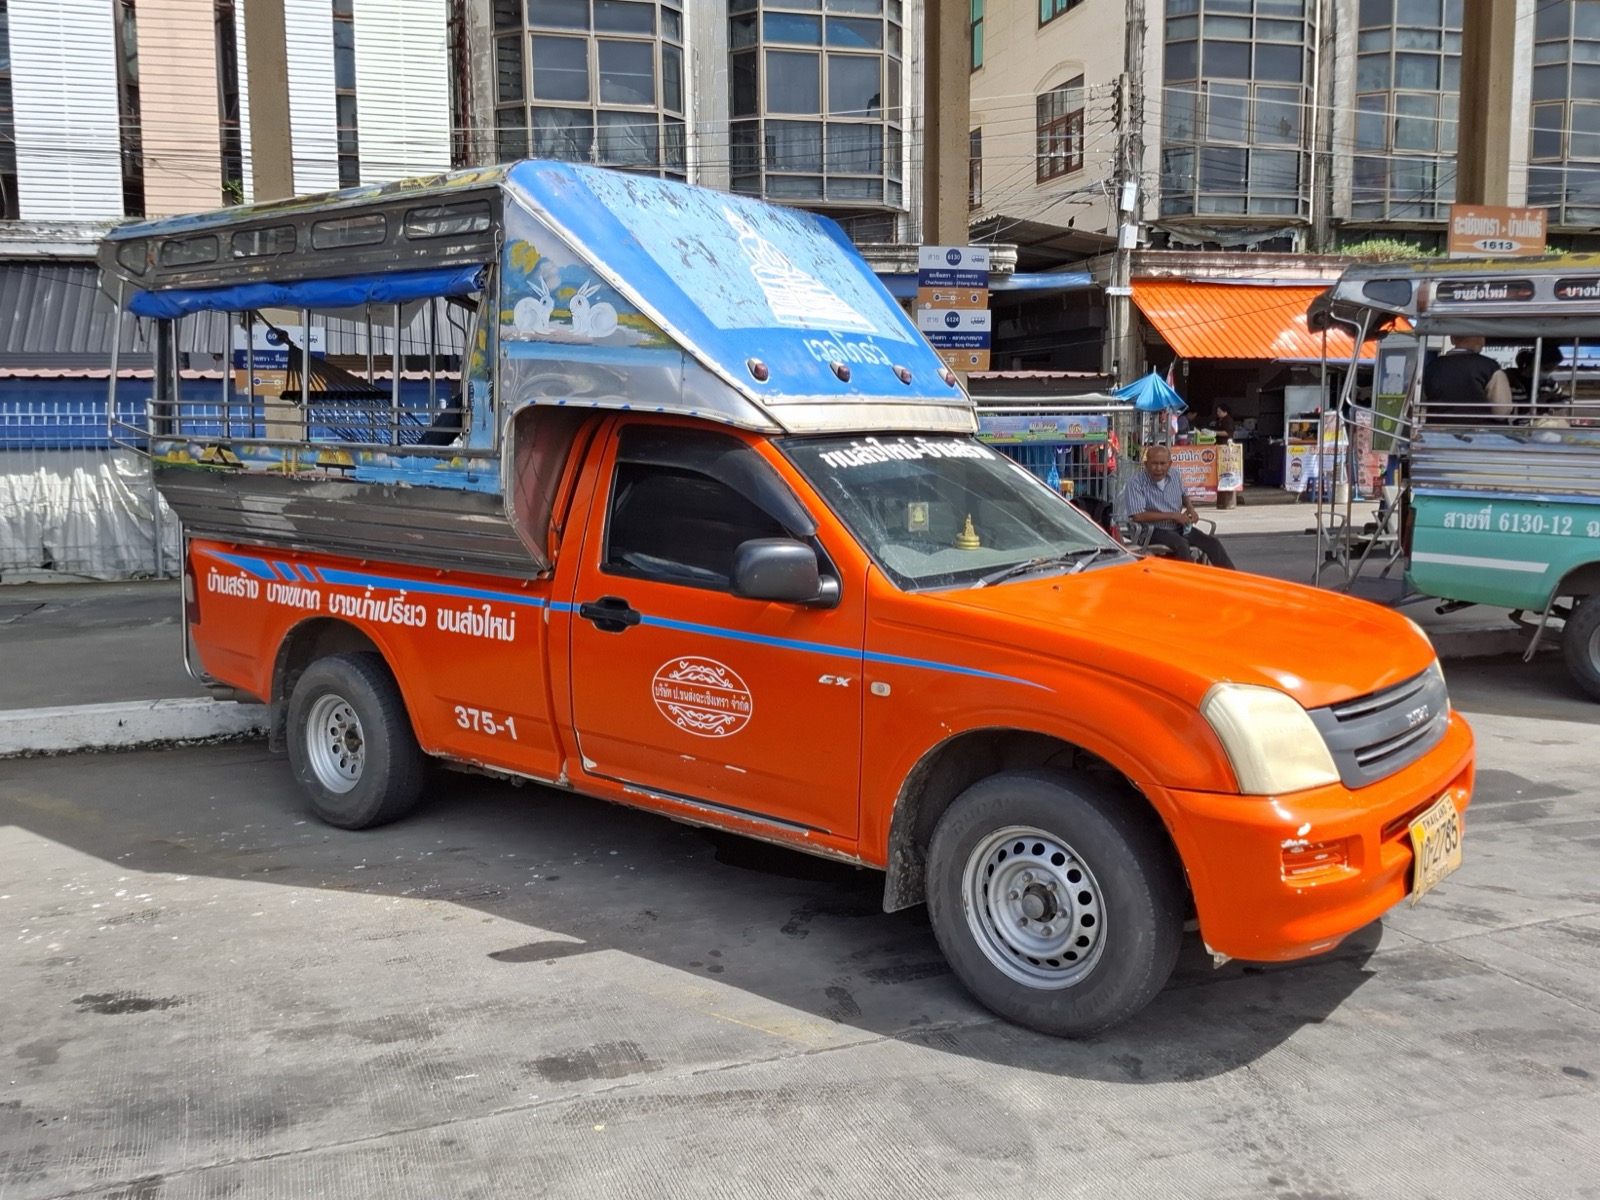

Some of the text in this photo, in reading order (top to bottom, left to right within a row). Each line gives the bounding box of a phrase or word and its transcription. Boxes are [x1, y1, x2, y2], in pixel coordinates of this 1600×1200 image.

[1454, 212, 1543, 238] ฉะเชิงเทรา บ้านโพธิ์
[1481, 241, 1513, 250] 1613
[1453, 284, 1508, 301] ขนส่งใหม่
[1202, 452, 1213, 460] 40
[1443, 504, 1493, 530] สายที่
[1499, 513, 1573, 535] 6130-12
[207, 566, 516, 642] บ้านสร้าง บางขนาก บางน้ำเปรี้ยว ขนส่งใหม่
[655, 682, 672, 698] บริษัท
[731, 694, 749, 712] จำกัด
[455, 705, 518, 741] 375-1
